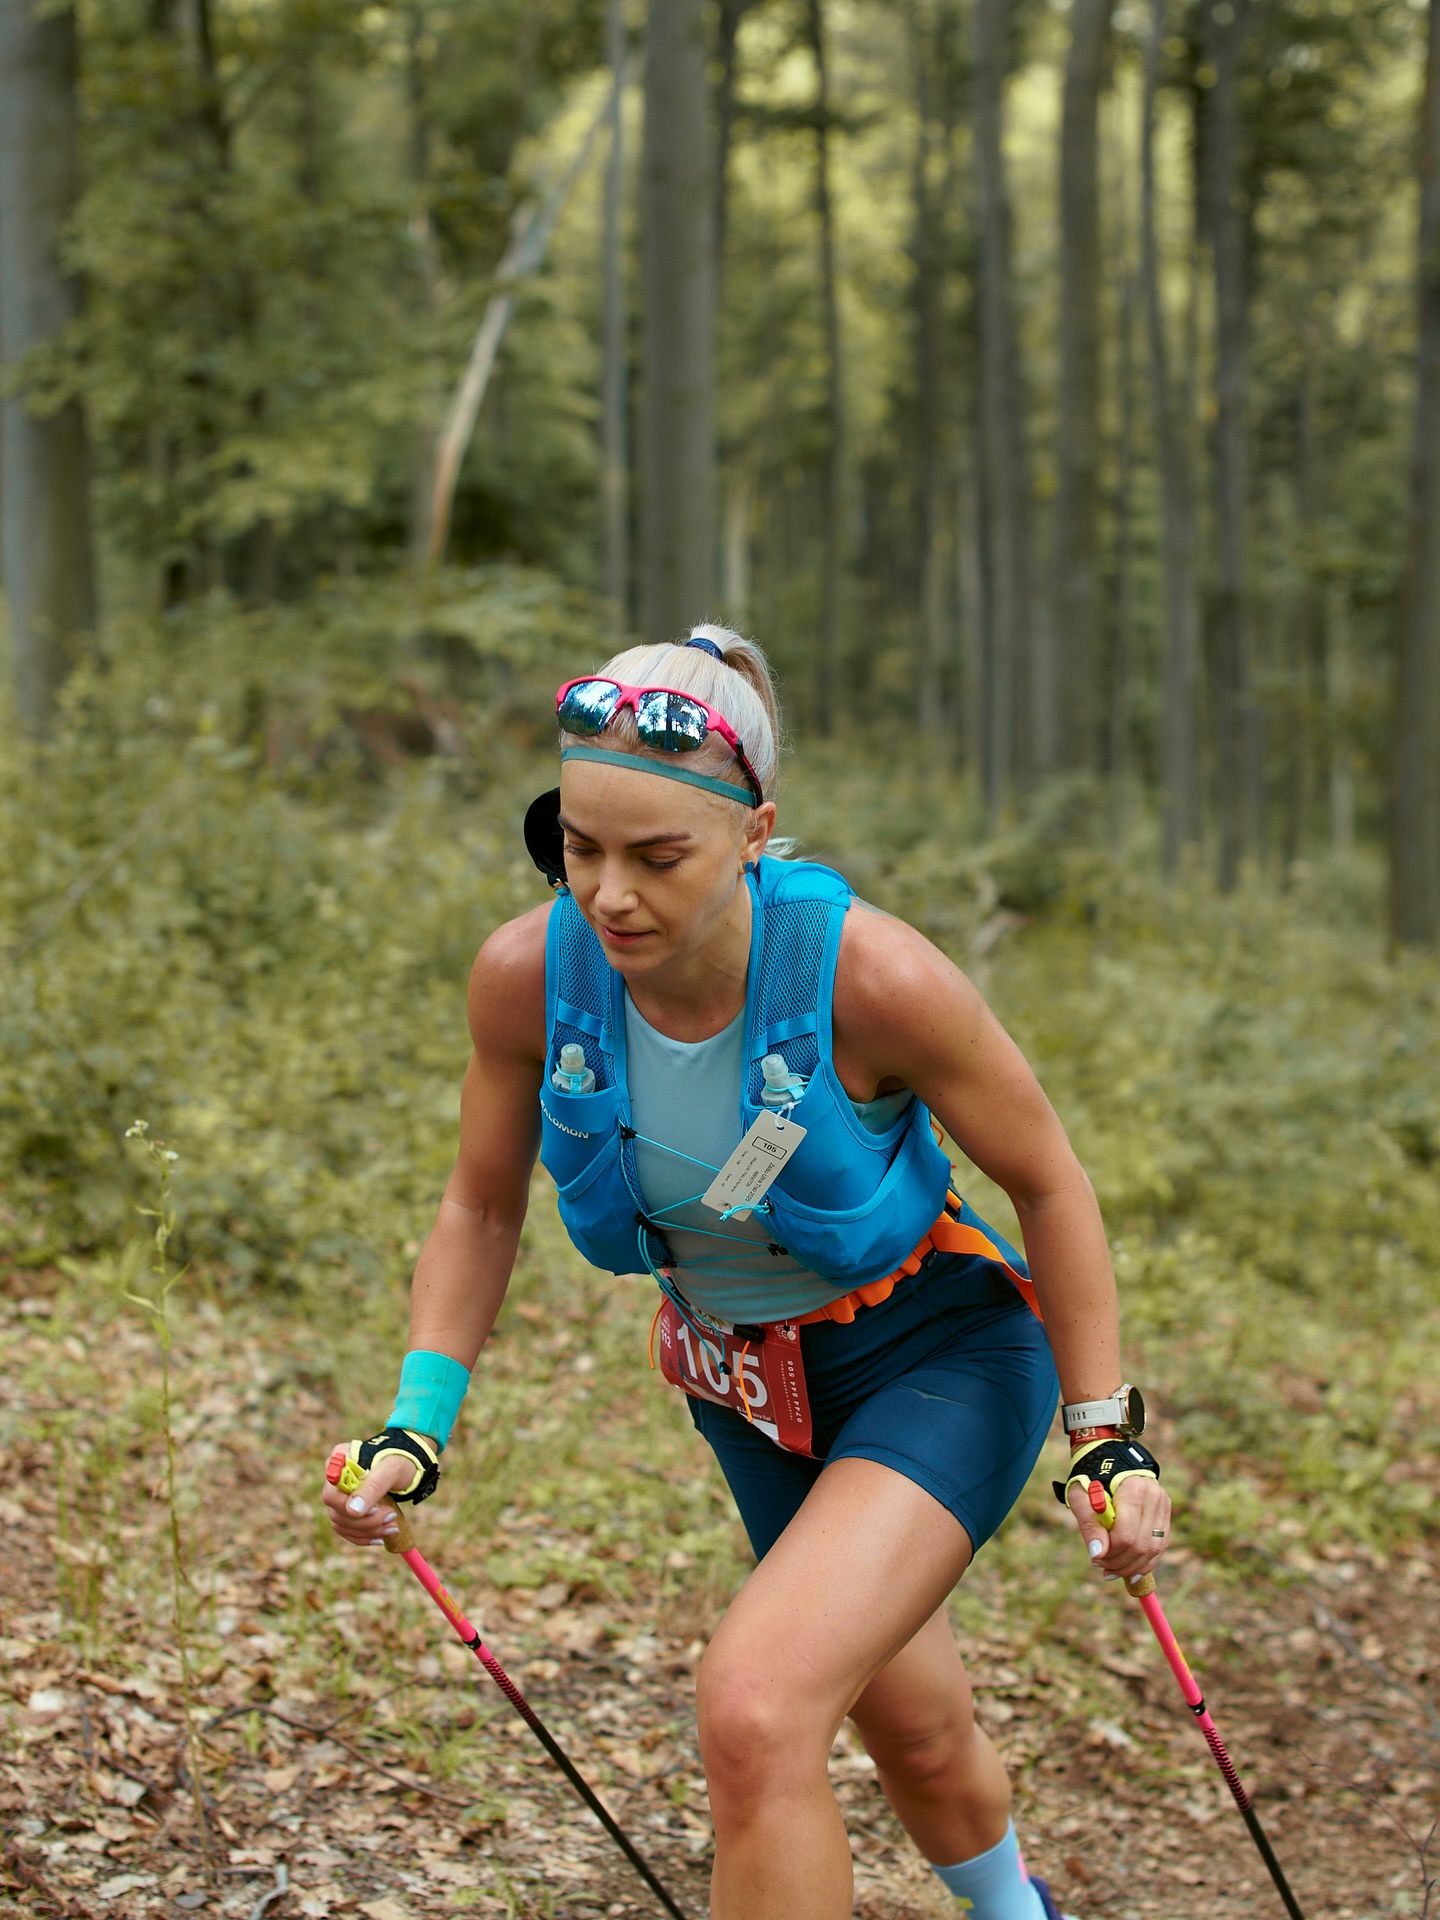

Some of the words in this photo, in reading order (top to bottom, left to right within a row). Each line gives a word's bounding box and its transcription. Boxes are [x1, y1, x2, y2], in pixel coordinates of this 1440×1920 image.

[763, 1142, 778, 1153] 105
[661, 1329, 672, 1349] 112
[677, 1322, 768, 1408] 105
[793, 1401, 803, 1423] 0744
